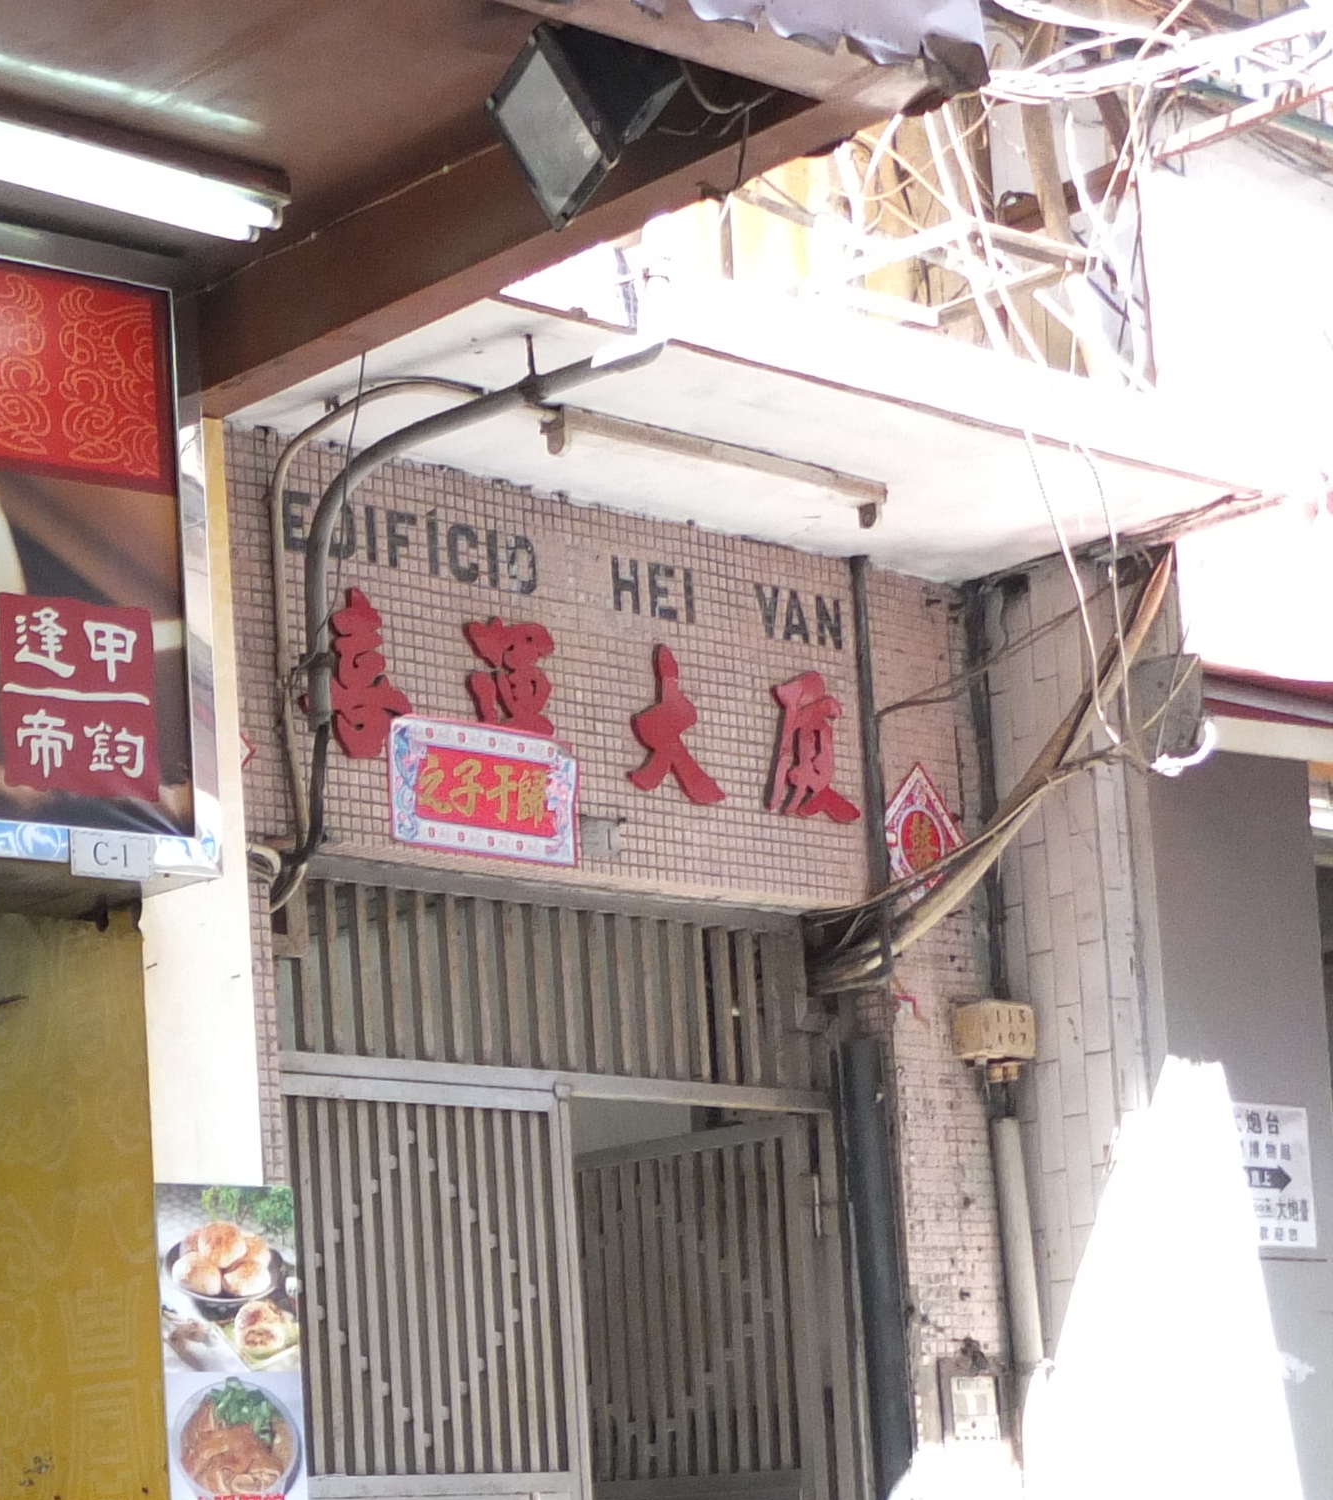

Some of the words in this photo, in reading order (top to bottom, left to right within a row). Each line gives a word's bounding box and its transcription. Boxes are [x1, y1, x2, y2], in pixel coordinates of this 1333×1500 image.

[610, 554, 696, 623] HEI
[753, 582, 843, 652] VAN
[14, 606, 137, 683] 逢甲
[16, 708, 145, 779] 帝鈞
[92, 840, 130, 868] C-1
